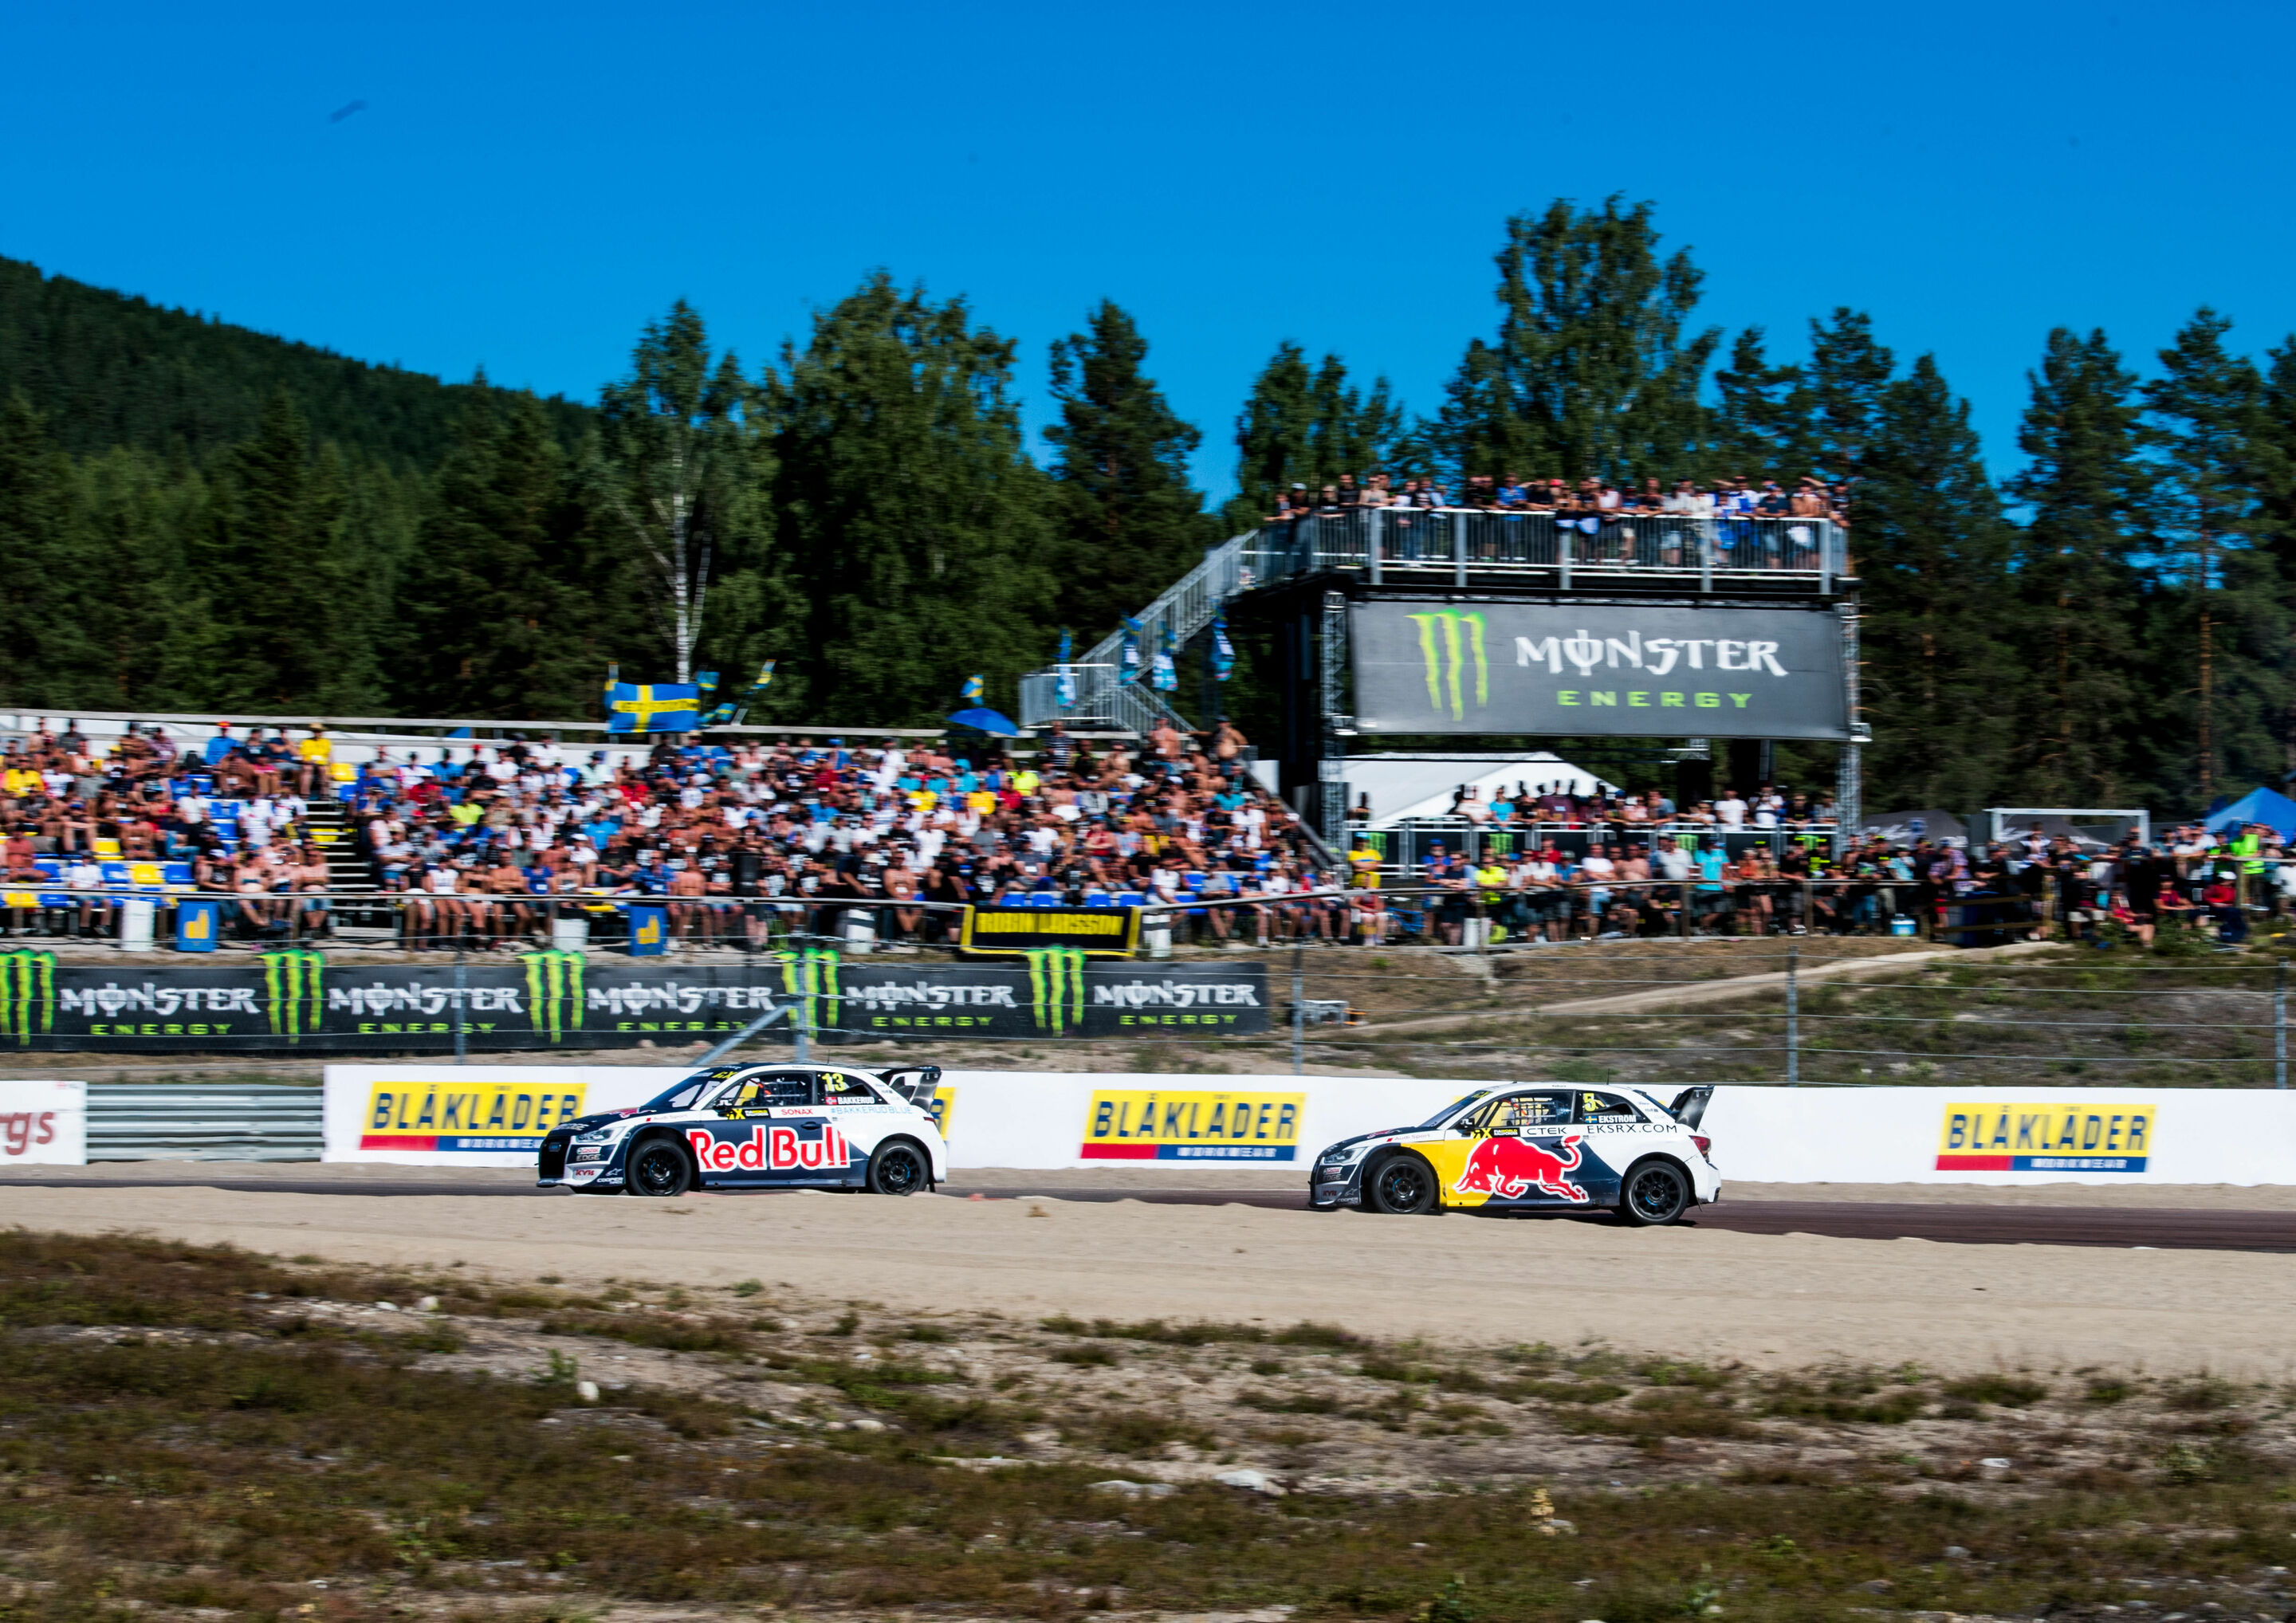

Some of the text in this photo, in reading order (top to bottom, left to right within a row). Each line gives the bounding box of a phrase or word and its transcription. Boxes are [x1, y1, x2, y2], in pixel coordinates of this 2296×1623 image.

[1516, 629, 1789, 677] MONSTER
[1557, 690, 1754, 708] ENERGY
[60, 982, 261, 1016] MONSTER
[328, 982, 525, 1016] MONSTER
[588, 981, 776, 1015] MONSTER
[846, 980, 1018, 1011] MONSTER
[1094, 980, 1260, 1008] MONSTER
[359, 1023, 496, 1034] ENERGY
[872, 1016, 993, 1027] ENERGY
[1120, 1014, 1237, 1024] ENERGY
[91, 1024, 232, 1035] ENERGY
[822, 1073, 844, 1091] 13
[838, 1096, 875, 1105] BAKKERUD
[1582, 1093, 1597, 1112] 5
[1094, 1093, 1297, 1138] BLÅKLÄDER
[1598, 1114, 1637, 1123] EKSTRÖM
[1587, 1124, 1677, 1134] EKSRX.COM
[1948, 1106, 2147, 1150] BLÅKLÄDER
[689, 1126, 848, 1169] Red Bull
